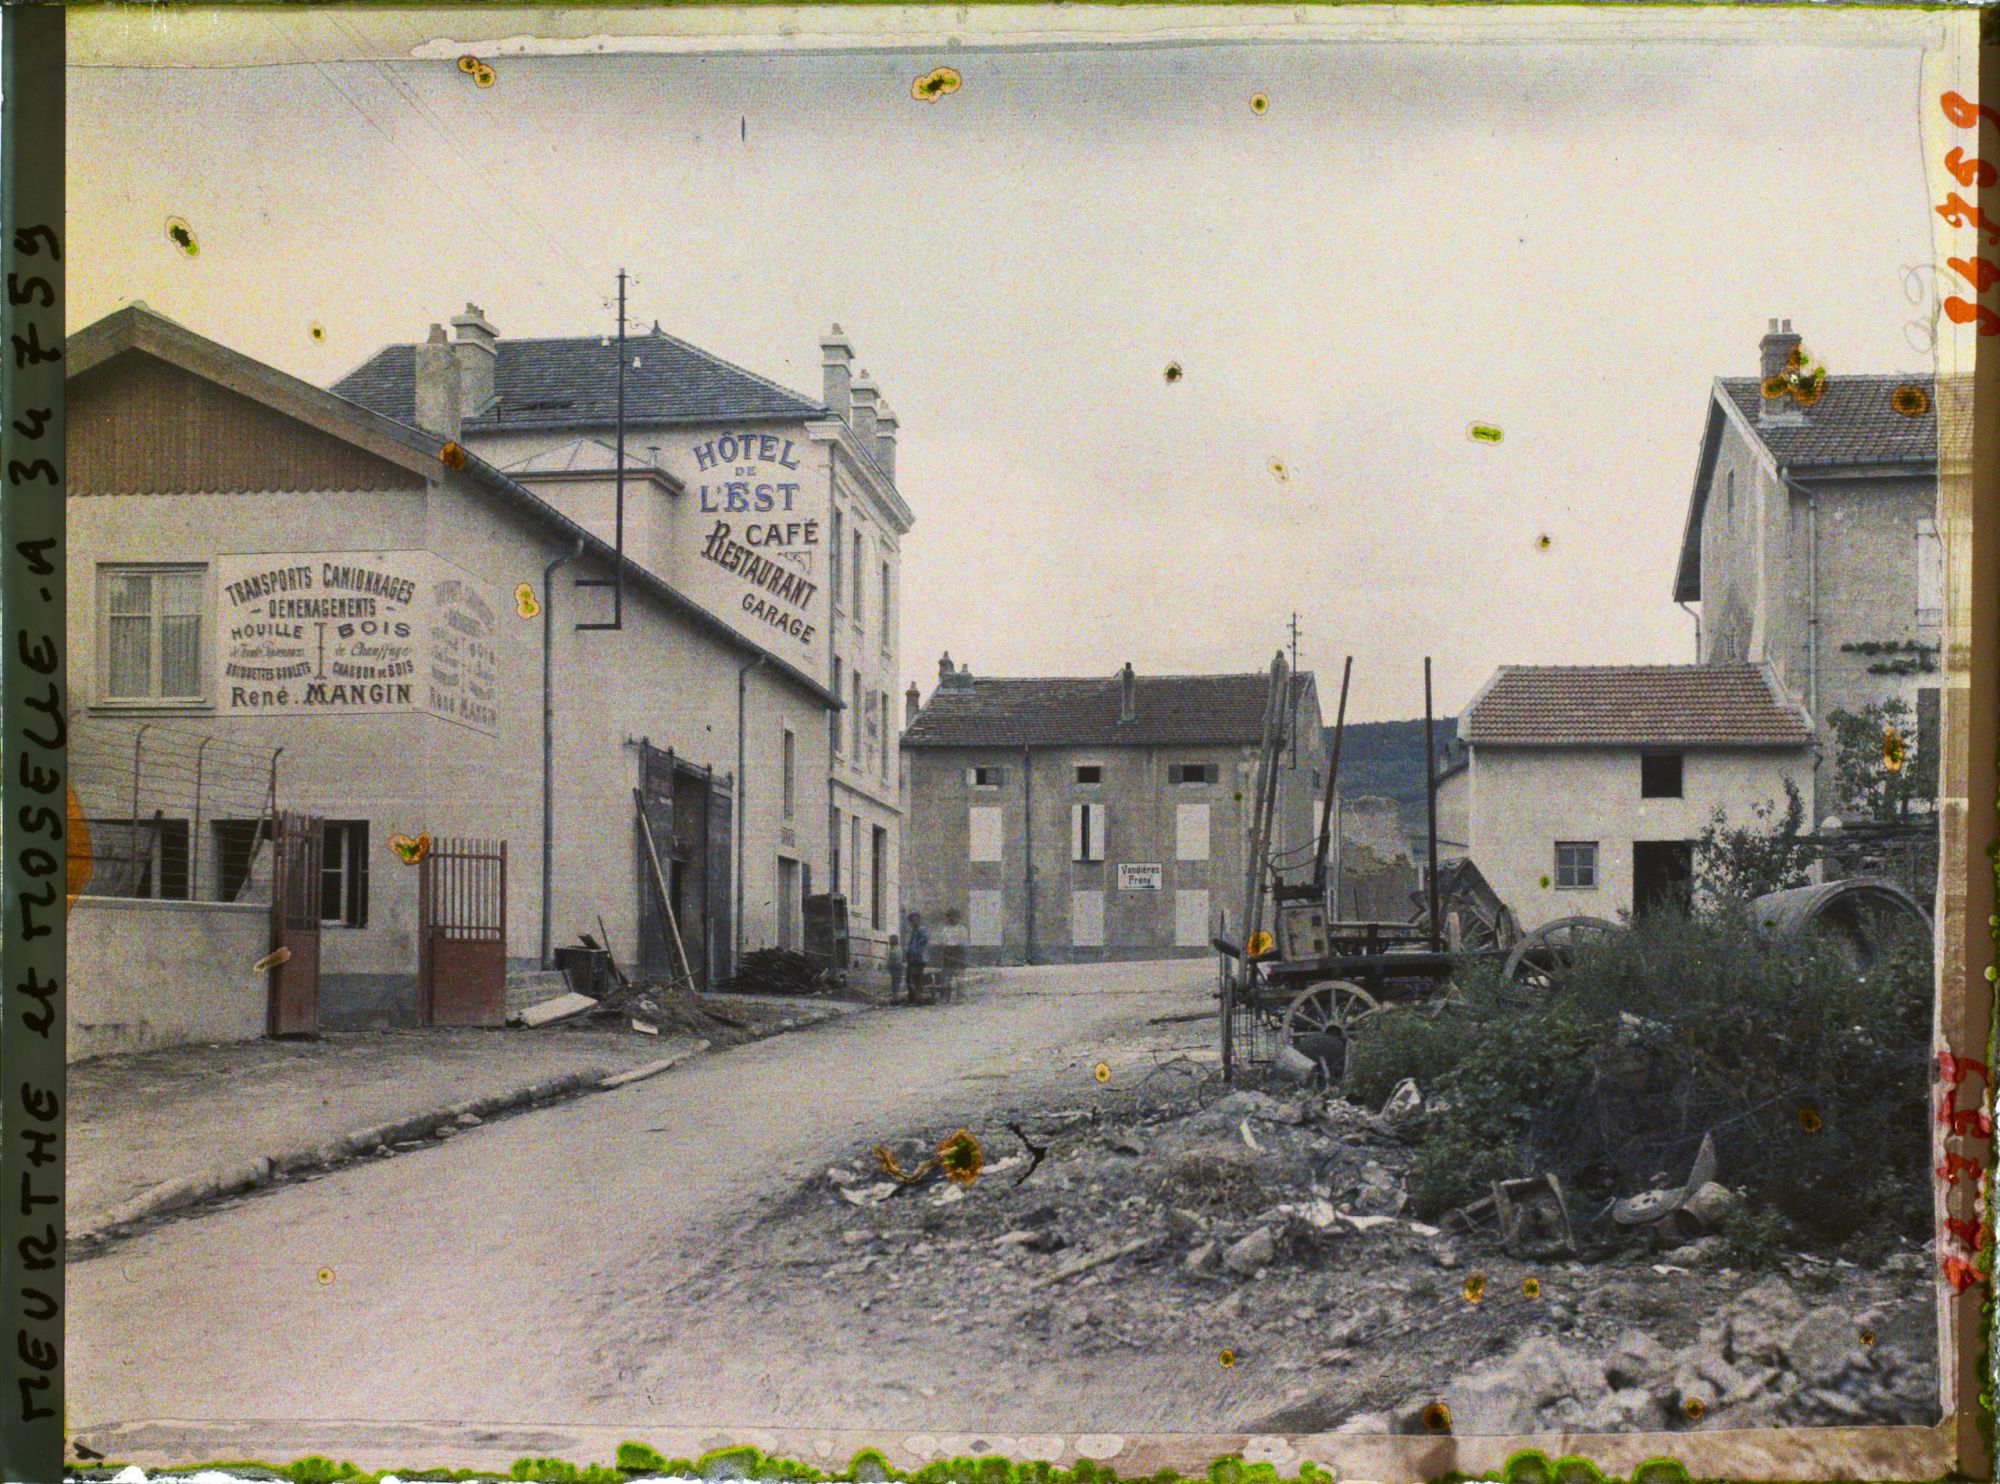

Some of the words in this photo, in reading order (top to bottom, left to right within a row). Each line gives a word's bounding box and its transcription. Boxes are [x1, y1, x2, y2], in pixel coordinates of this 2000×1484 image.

[692, 431, 800, 472] HÔTEL
[735, 466, 756, 477] DE
[700, 481, 800, 513] L'EST
[745, 519, 819, 546] CAFÉ
[701, 520, 817, 611] RESTAURANT
[225, 566, 312, 606] TRANSPORTS
[322, 563, 416, 605] CAMIONNAGES
[231, 623, 303, 640] HOUILLE
[338, 621, 411, 638] BOIS
[742, 593, 816, 644] GARAGE
[304, 682, 413, 705] MANGIN
[17, 967, 58, 1039] et
[18, 1080, 60, 1422] MEURTHE
